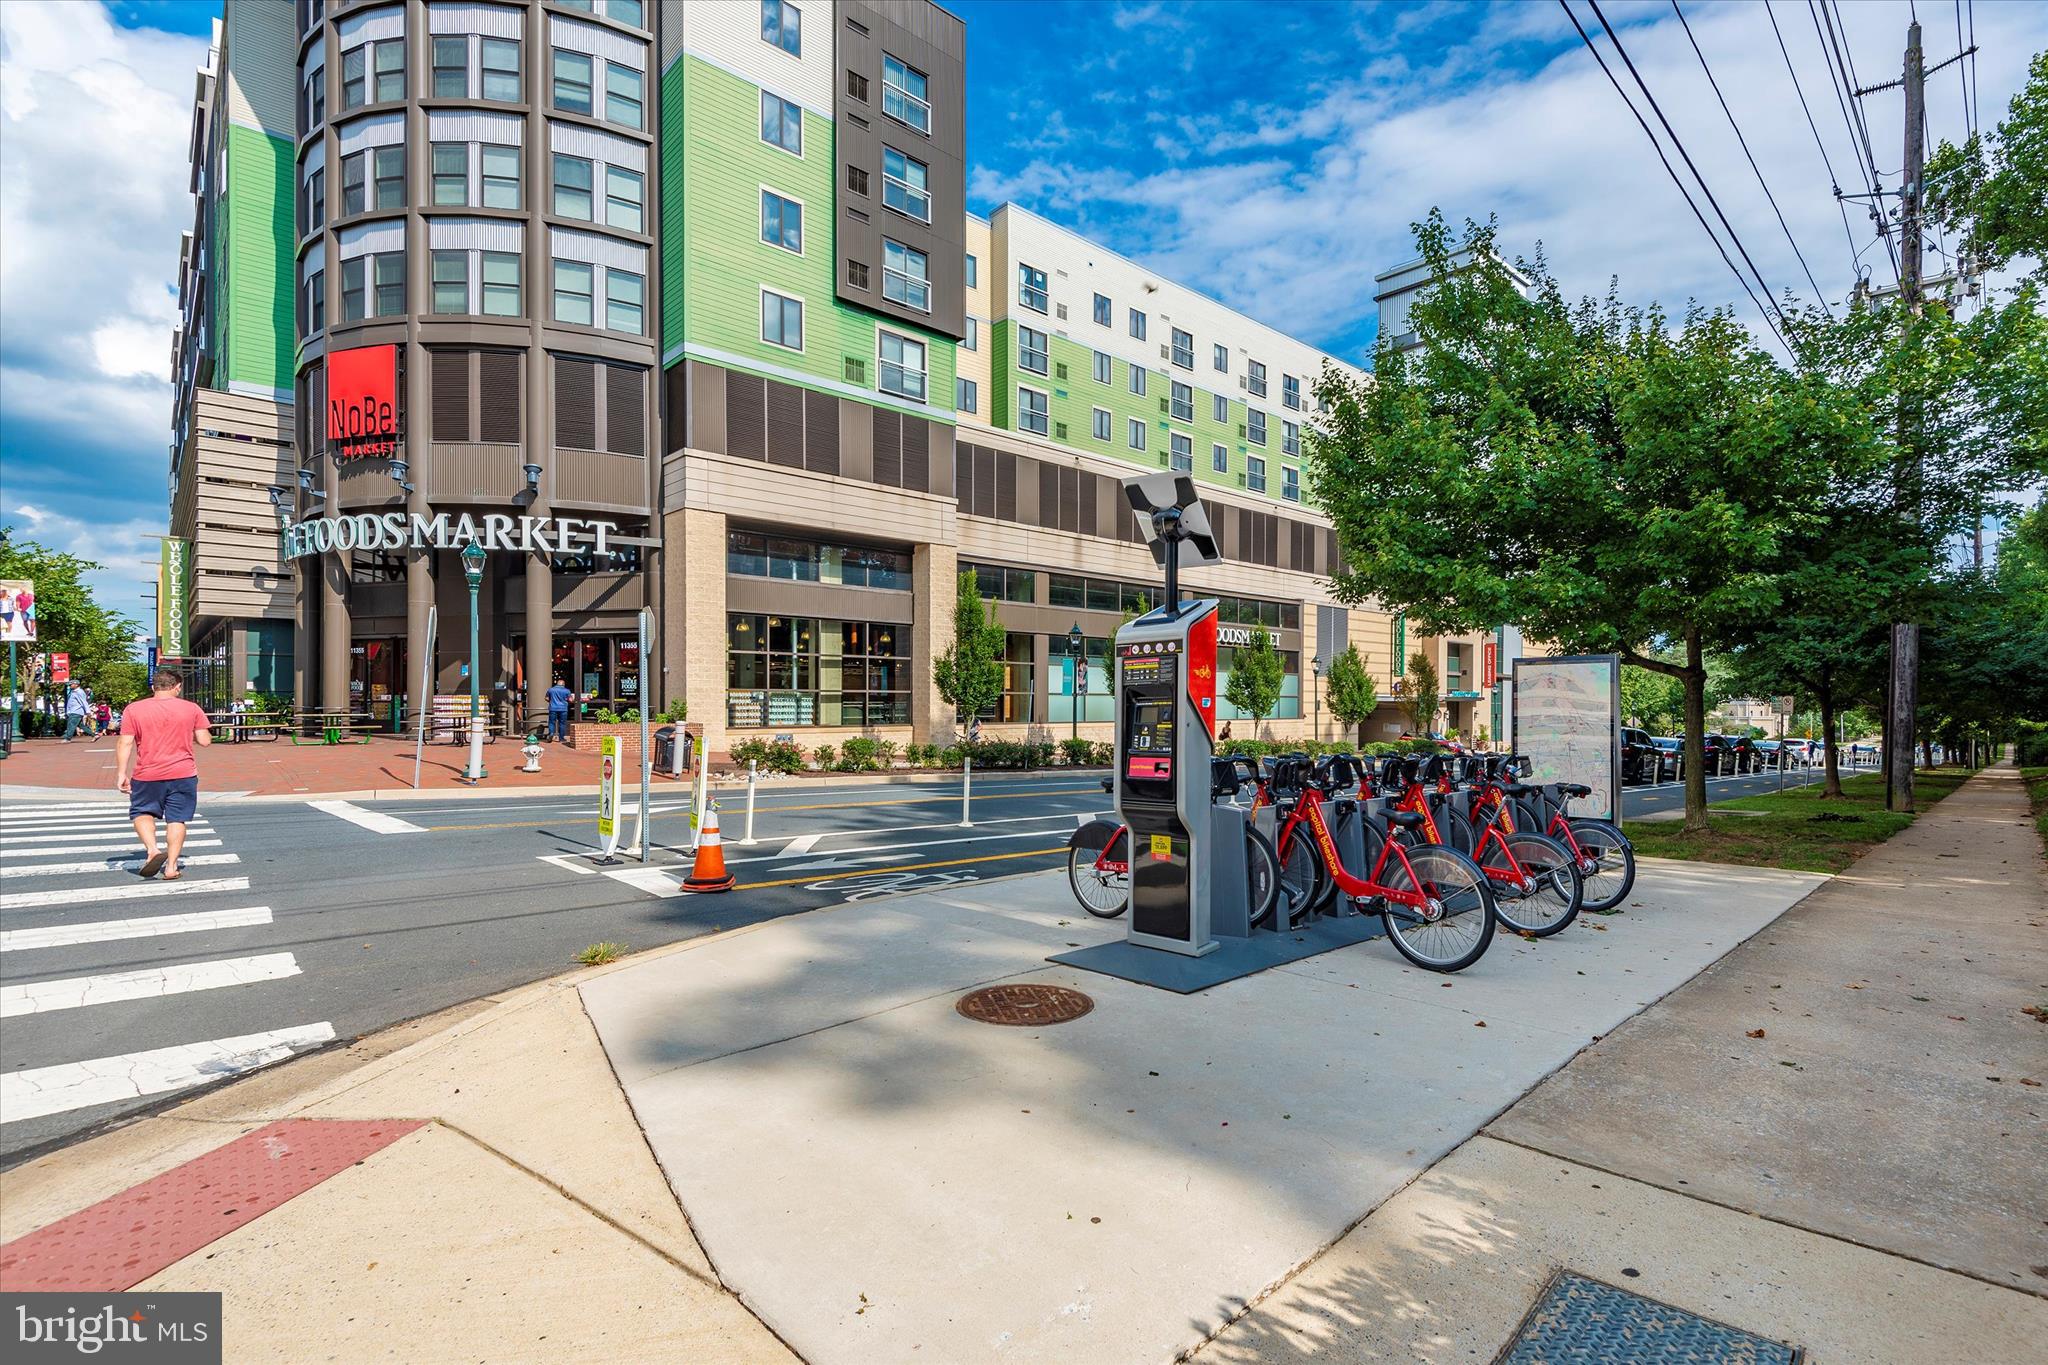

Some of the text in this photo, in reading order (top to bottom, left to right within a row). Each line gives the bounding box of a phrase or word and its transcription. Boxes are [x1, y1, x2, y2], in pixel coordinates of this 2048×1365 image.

[331, 396, 392, 439] NoBe
[343, 441, 396, 457] MARKET
[169, 598, 184, 650] FOODS
[1308, 806, 1339, 877] capital bikeshare
